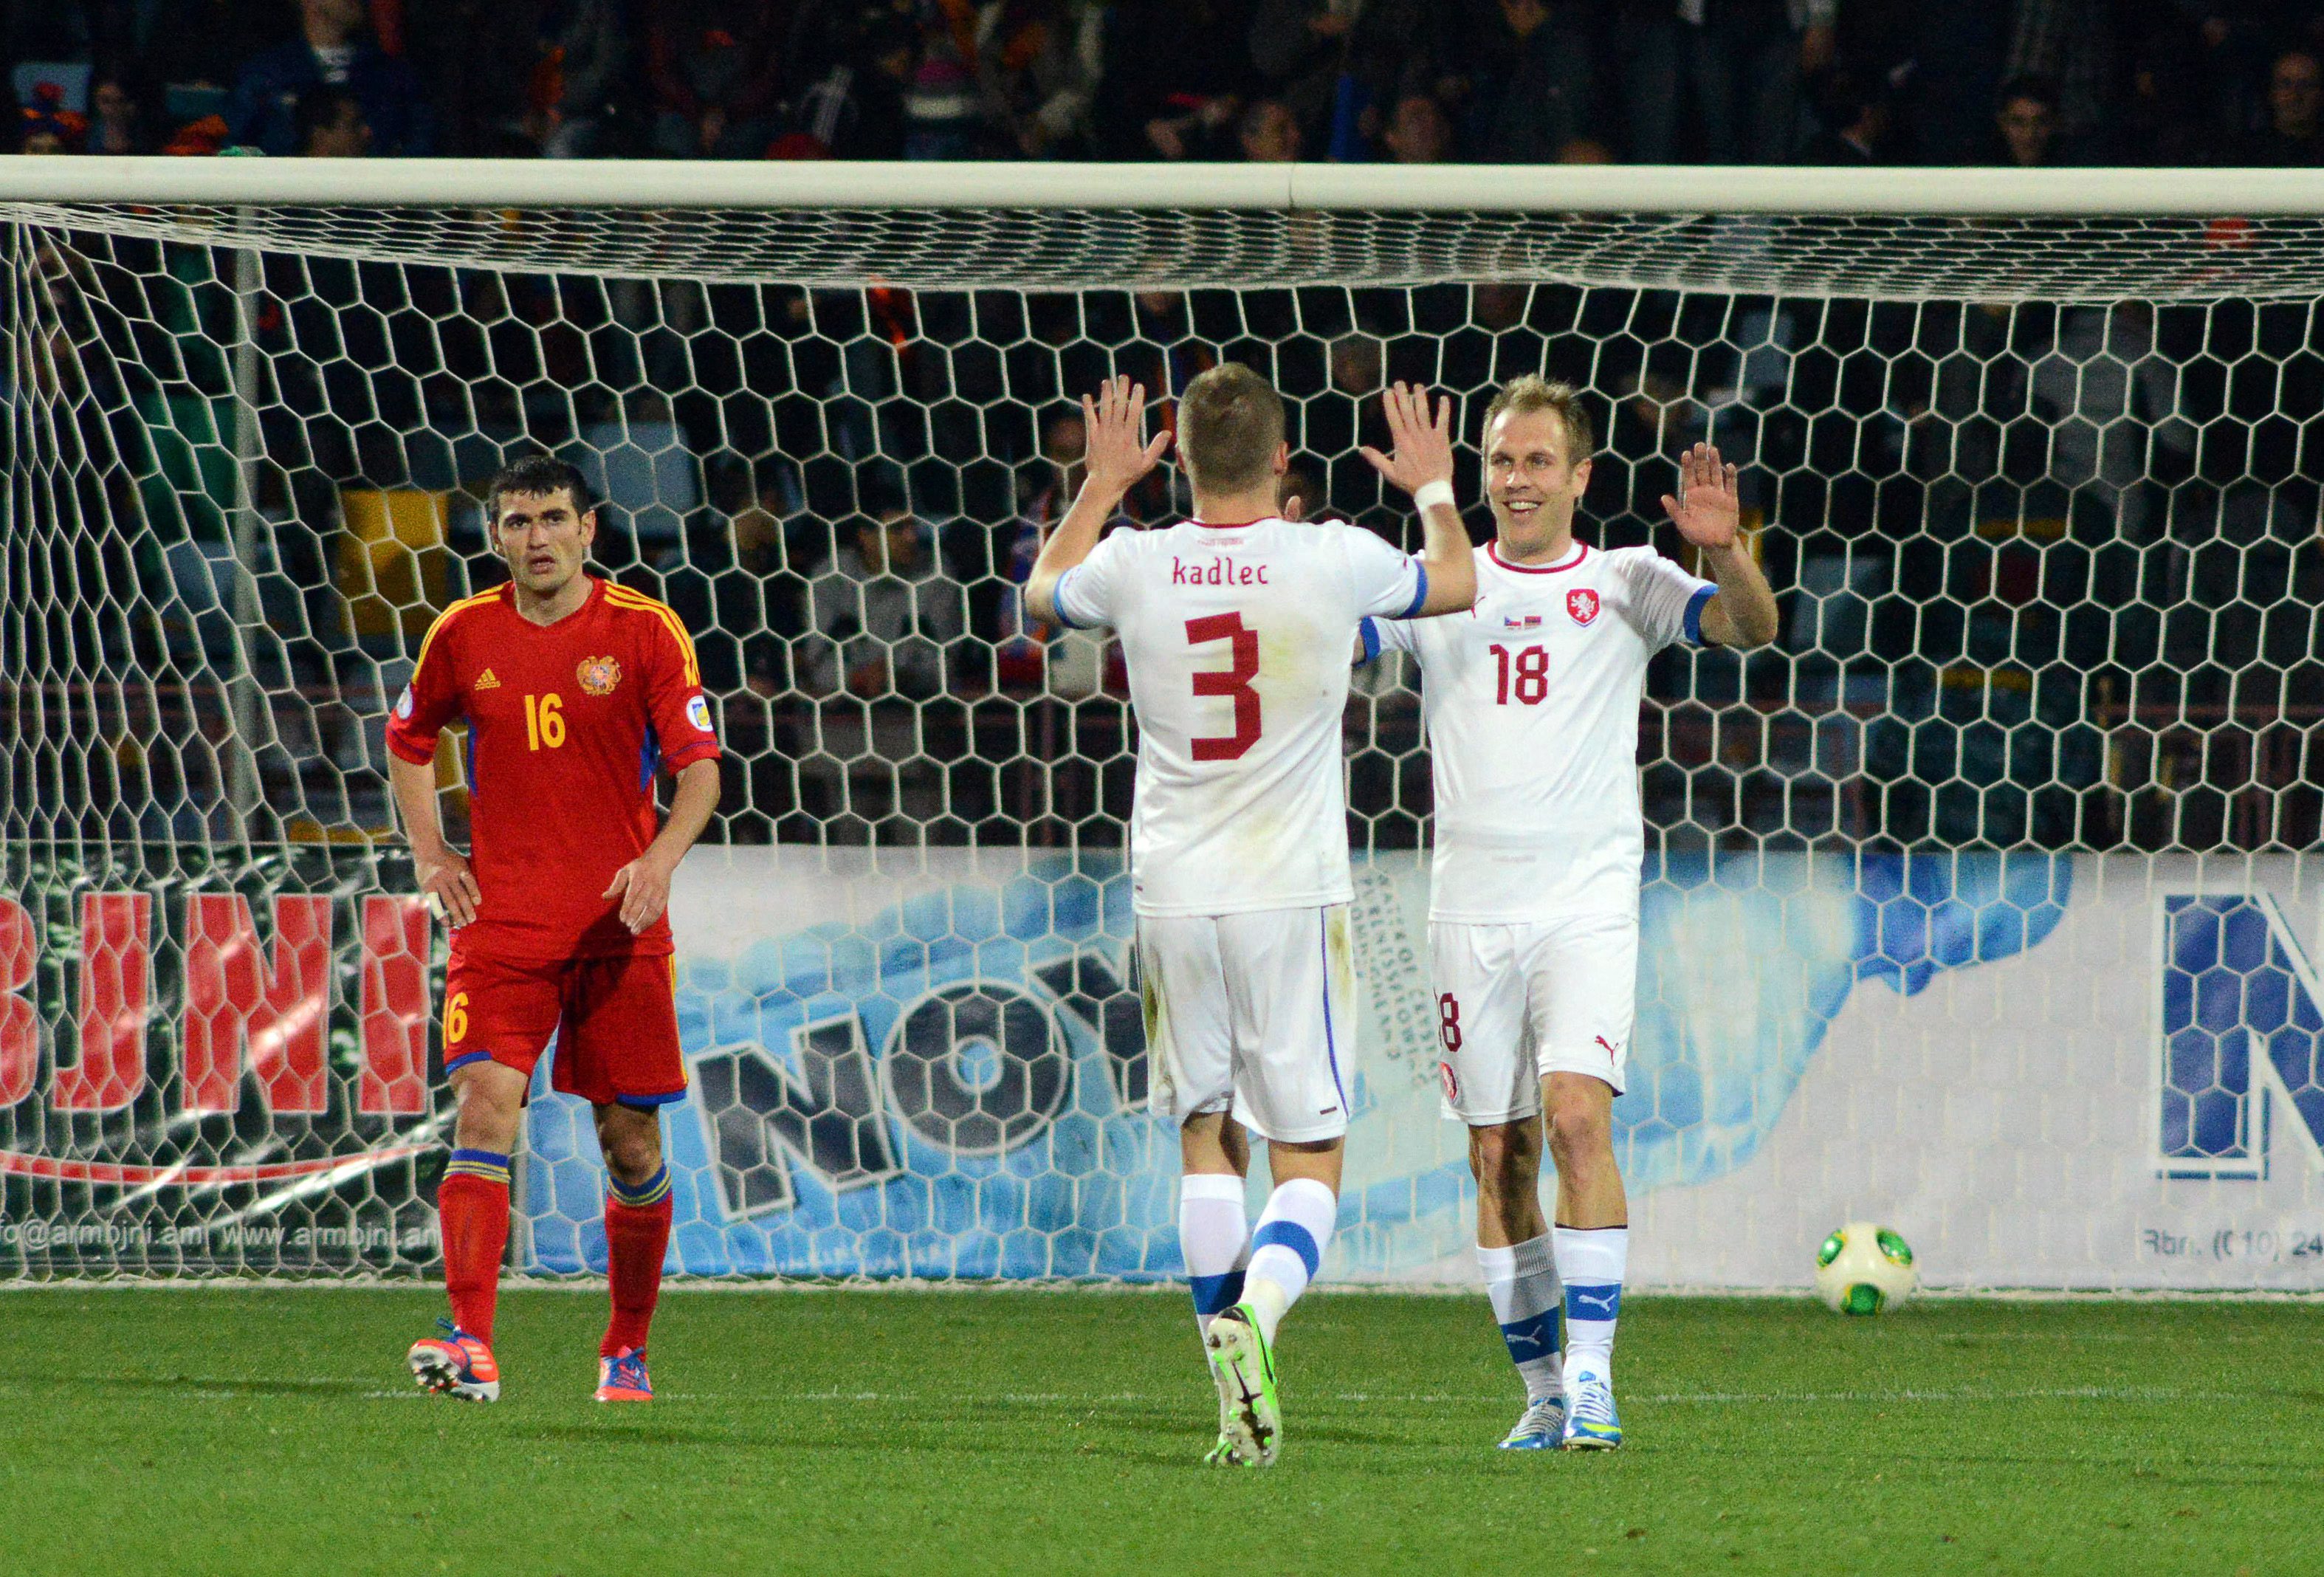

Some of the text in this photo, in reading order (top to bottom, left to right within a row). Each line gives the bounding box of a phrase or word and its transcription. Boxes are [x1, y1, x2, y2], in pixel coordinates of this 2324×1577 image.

[1172, 556, 1268, 585] kadlec
[1184, 611, 1262, 762] 3
[1489, 644, 1549, 705] 18
[525, 693, 566, 751] 16
[0, 1218, 440, 1251] o@armbjni.am www.armbjn.am
